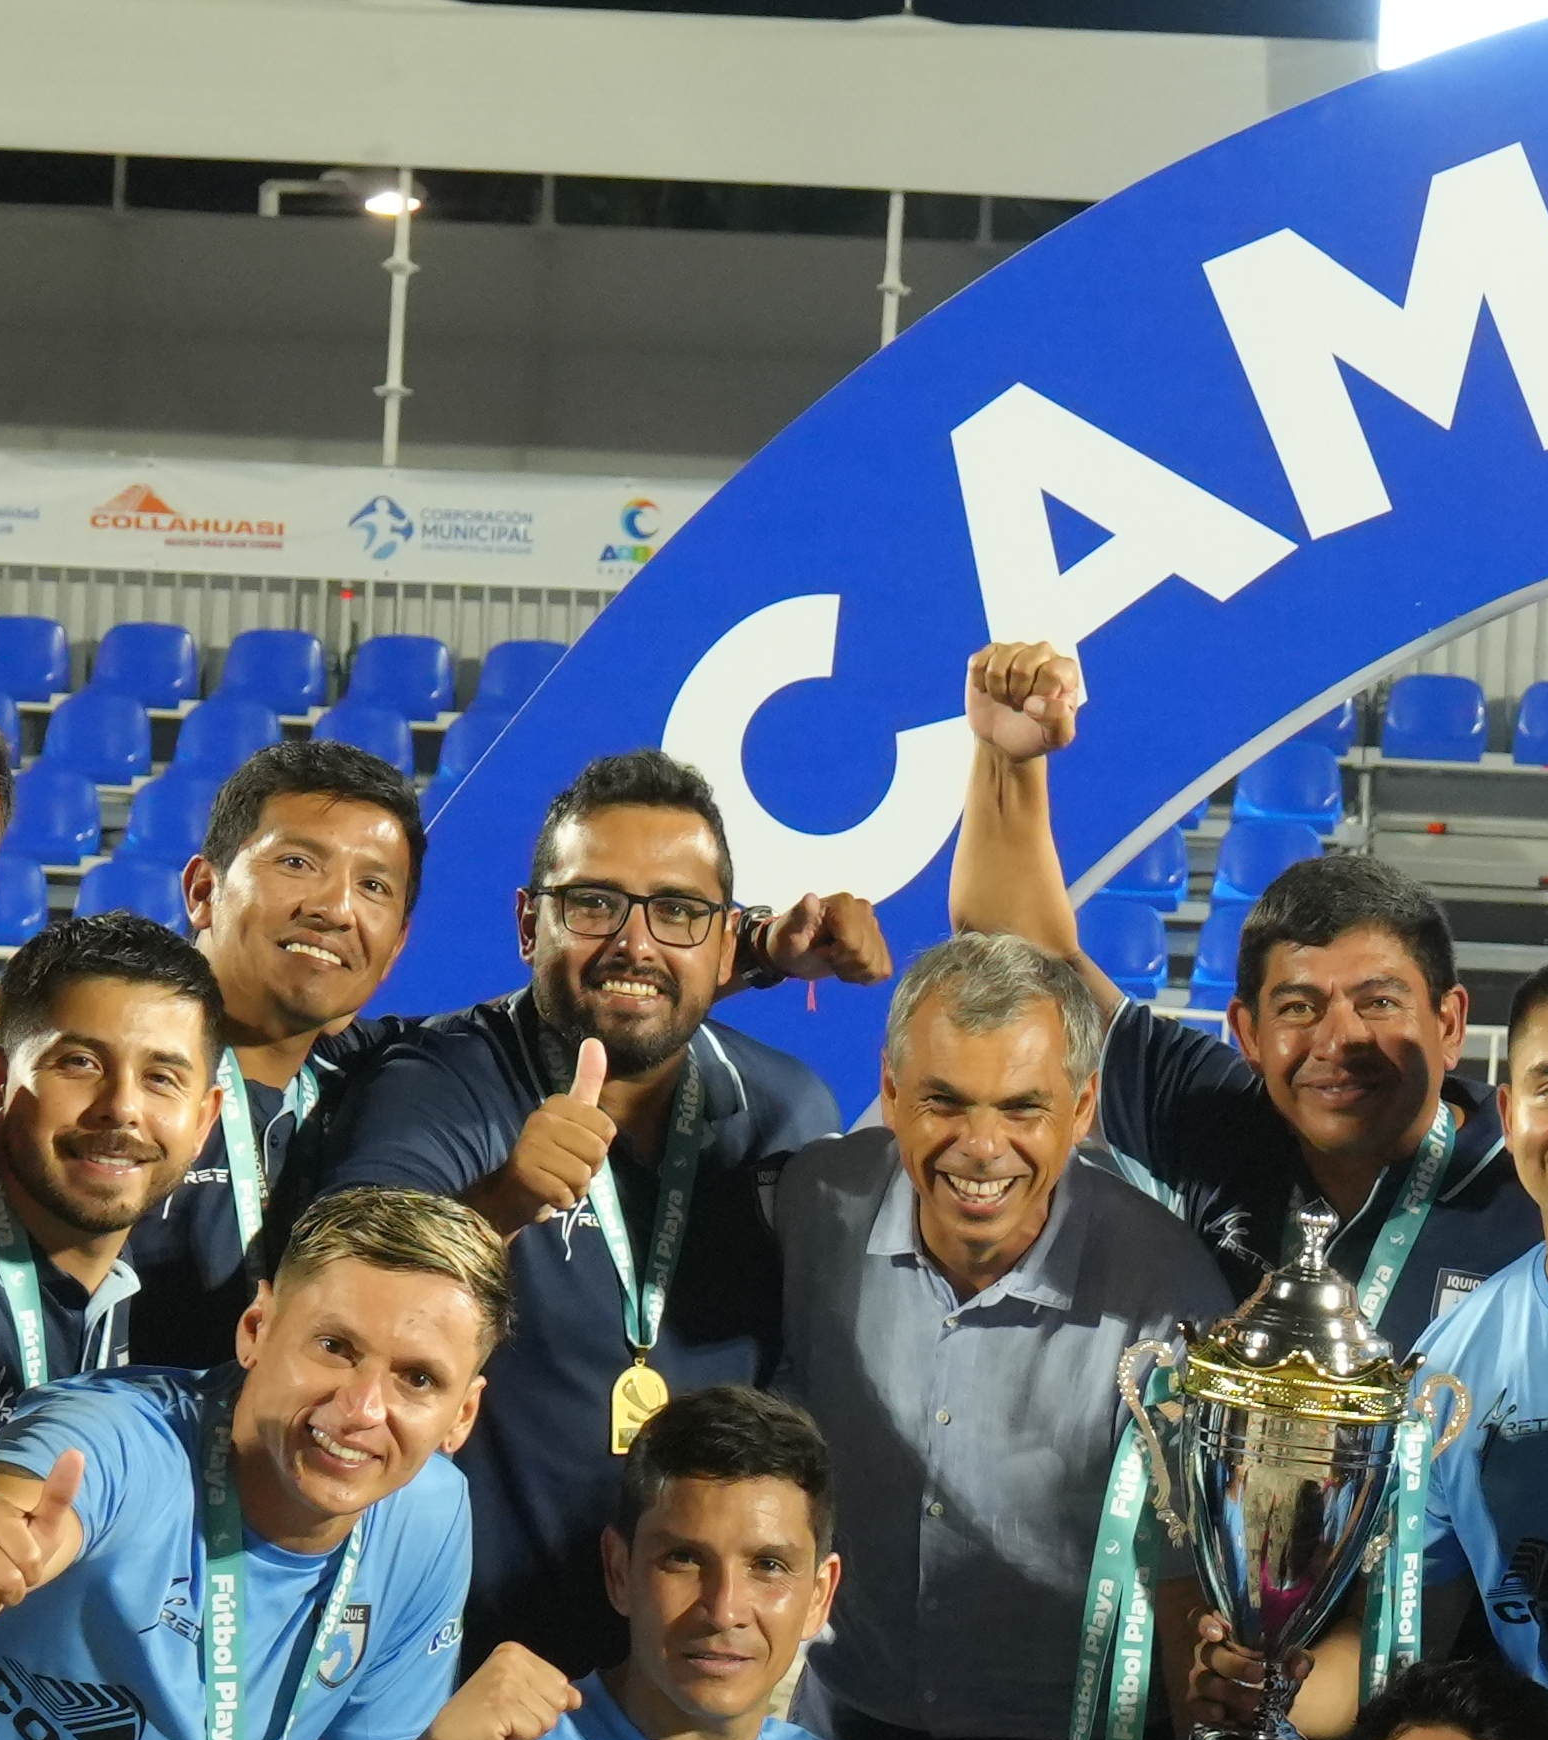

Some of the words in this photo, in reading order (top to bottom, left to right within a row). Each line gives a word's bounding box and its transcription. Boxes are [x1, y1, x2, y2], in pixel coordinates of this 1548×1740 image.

[90, 512, 286, 537] COLLAHUASI
[421, 524, 533, 543] MUNICIPAL
[1359, 1265, 1394, 1321] laya
[209, 1572, 237, 1674] Fútbol
[1085, 1577, 1116, 1657] Playa
[1123, 1565, 1151, 1643] Playa
[1398, 1552, 1419, 1645] Fútbol
